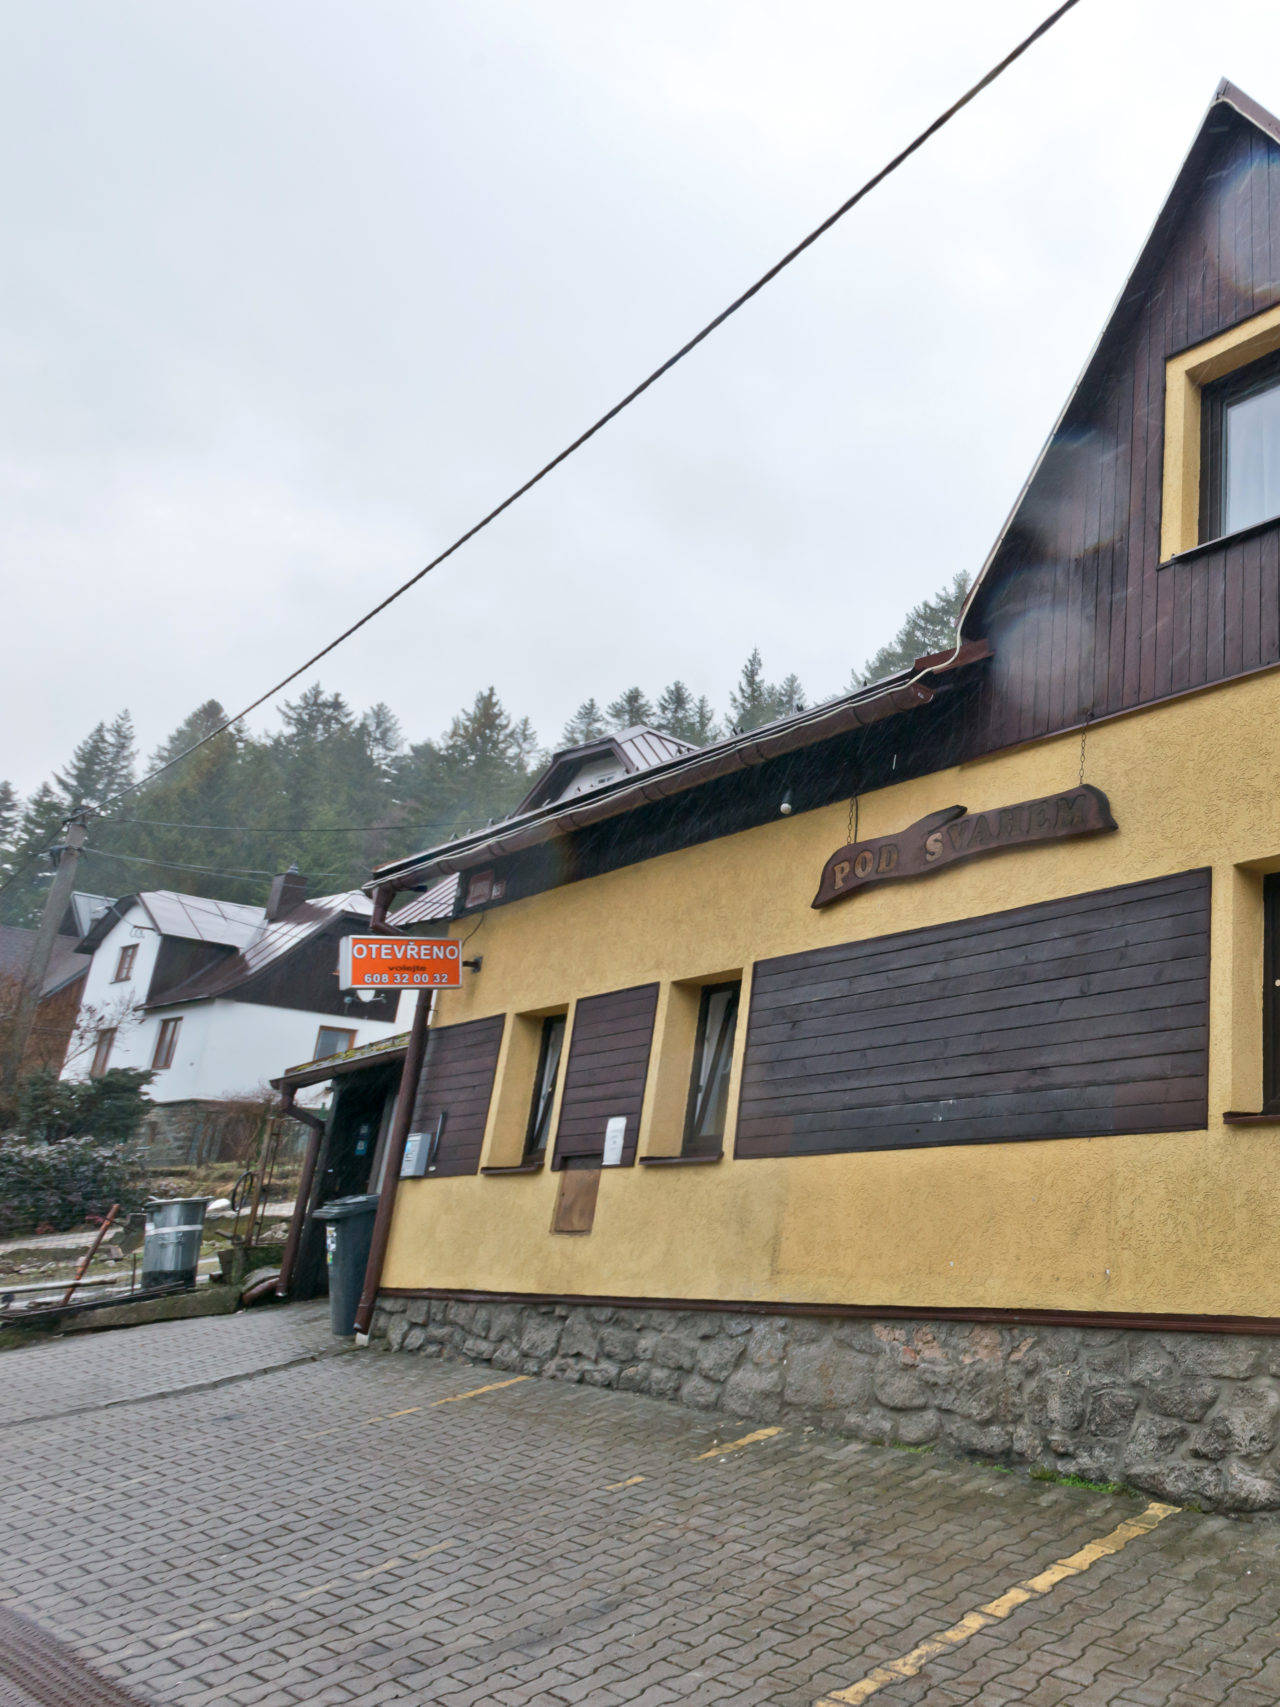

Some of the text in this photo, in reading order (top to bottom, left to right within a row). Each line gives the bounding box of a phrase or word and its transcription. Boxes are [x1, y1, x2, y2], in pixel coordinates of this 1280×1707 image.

[833, 844, 898, 890] POD
[353, 942, 458, 959] OTEVŘENO
[364, 973, 448, 983] 608 32 00 32
